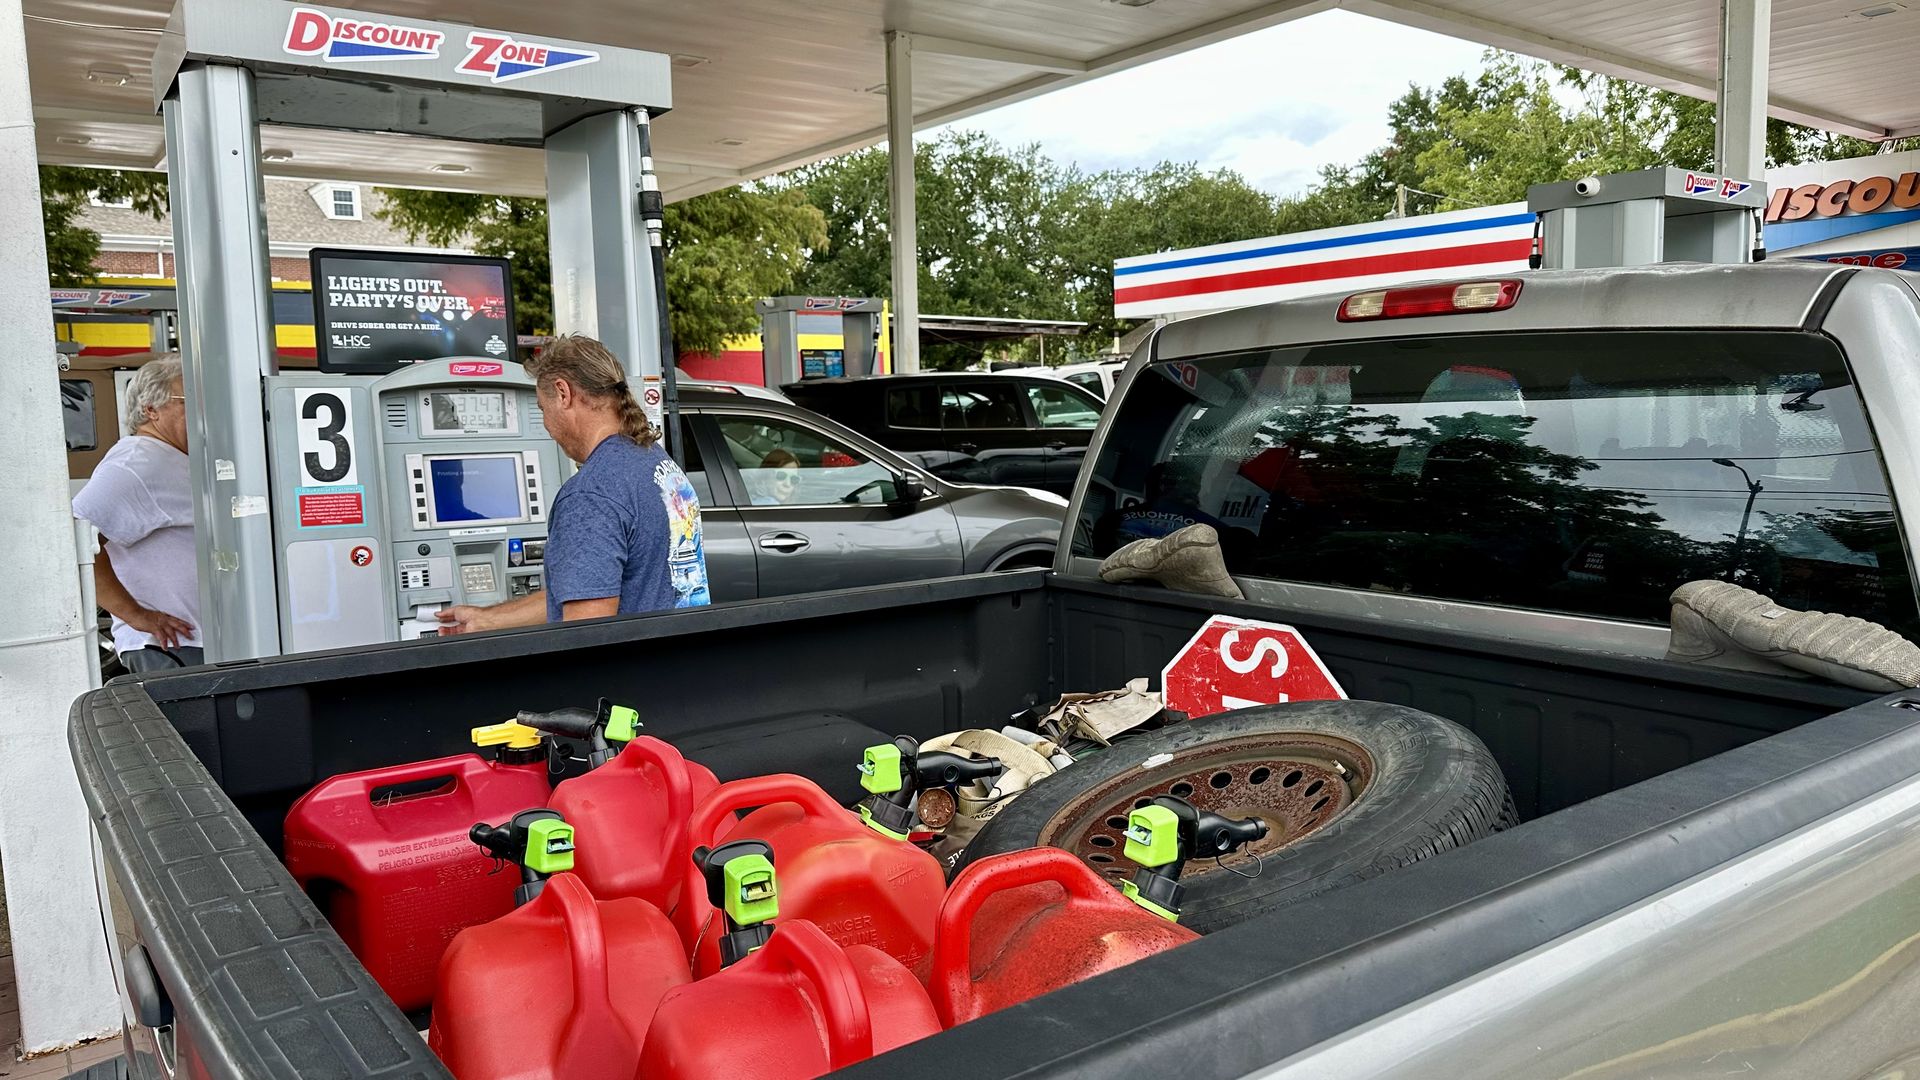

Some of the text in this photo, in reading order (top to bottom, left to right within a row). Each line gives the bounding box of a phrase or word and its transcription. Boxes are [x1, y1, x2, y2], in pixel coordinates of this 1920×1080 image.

[288, 12, 547, 72] DISCOUNT ZONE
[1686, 174, 1740, 196] DISCOUNT ZONE
[328, 276, 447, 294] LIGHTS OUT.
[97, 291, 128, 304] ZONE
[329, 293, 414, 309] PARTY'S
[417, 295, 474, 310] OVER.
[331, 321, 358, 329] DRIVE
[358, 322, 385, 330] SOBER
[343, 335, 371, 347] HSC
[423, 397, 430, 407] $
[301, 393, 351, 482] 3
[378, 844, 412, 858] DANGER
[378, 856, 416, 871] PELIGRO
